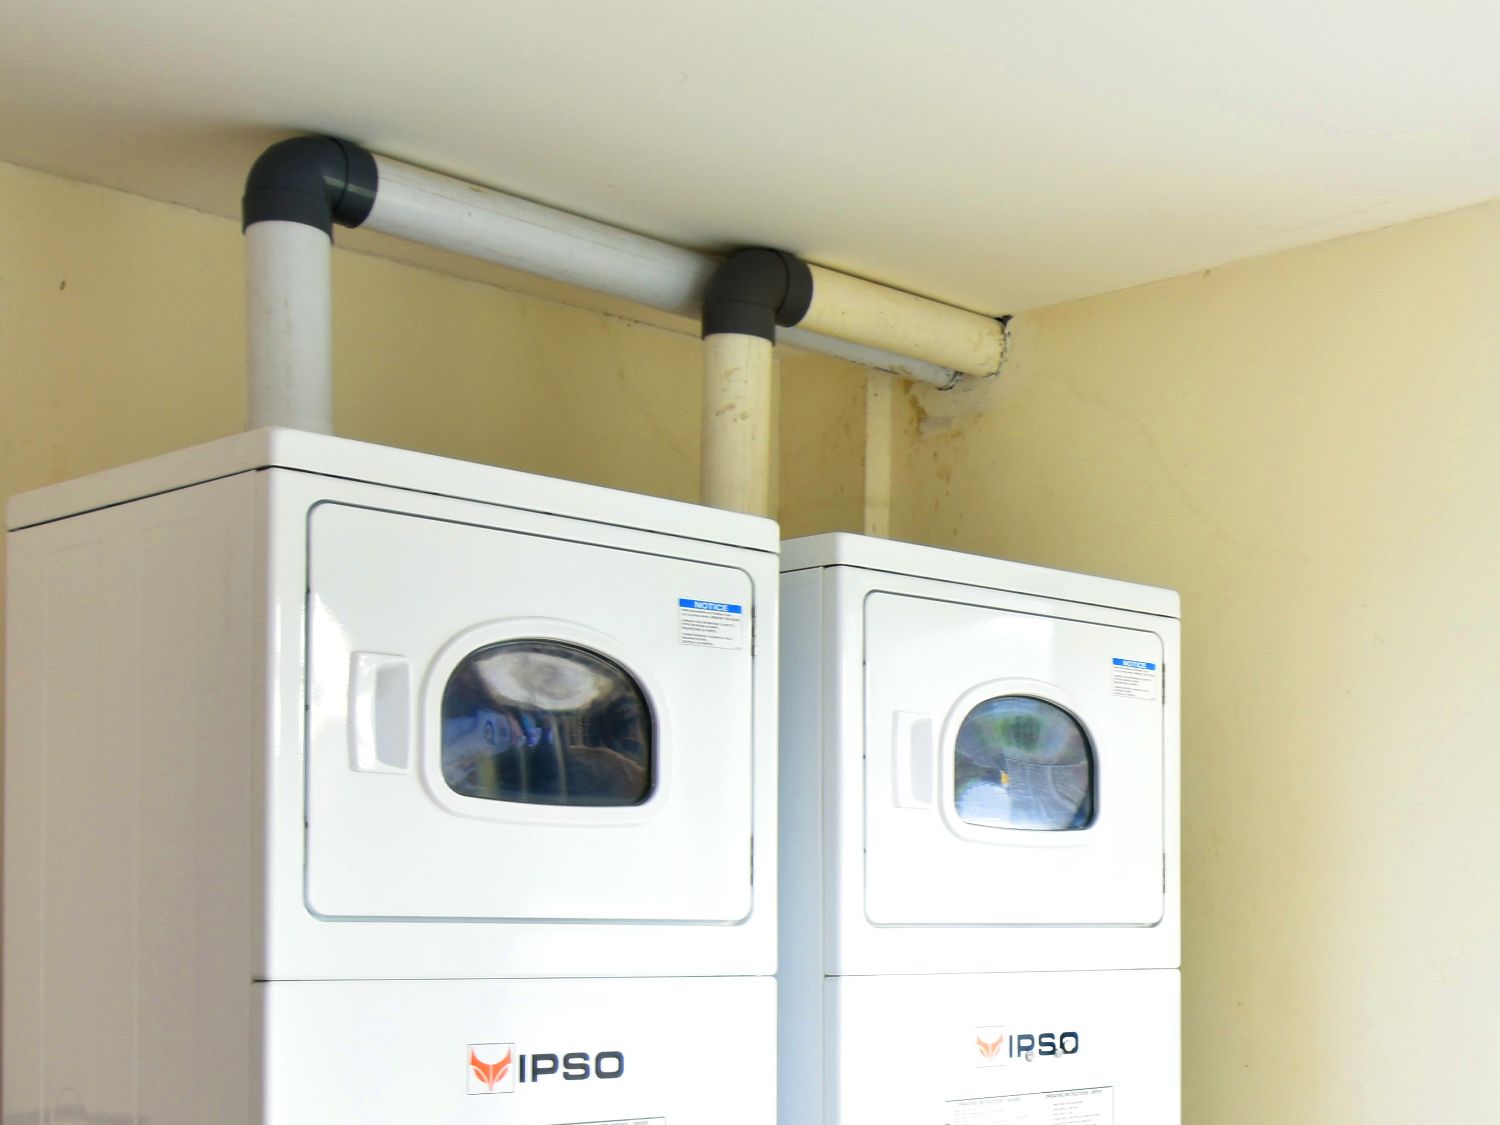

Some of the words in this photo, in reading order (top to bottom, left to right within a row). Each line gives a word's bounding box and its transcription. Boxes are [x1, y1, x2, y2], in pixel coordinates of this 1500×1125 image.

[694, 601, 729, 612] NOTICE
[1009, 1031, 1079, 1058] IPSO
[519, 1051, 625, 1083] IPSO
